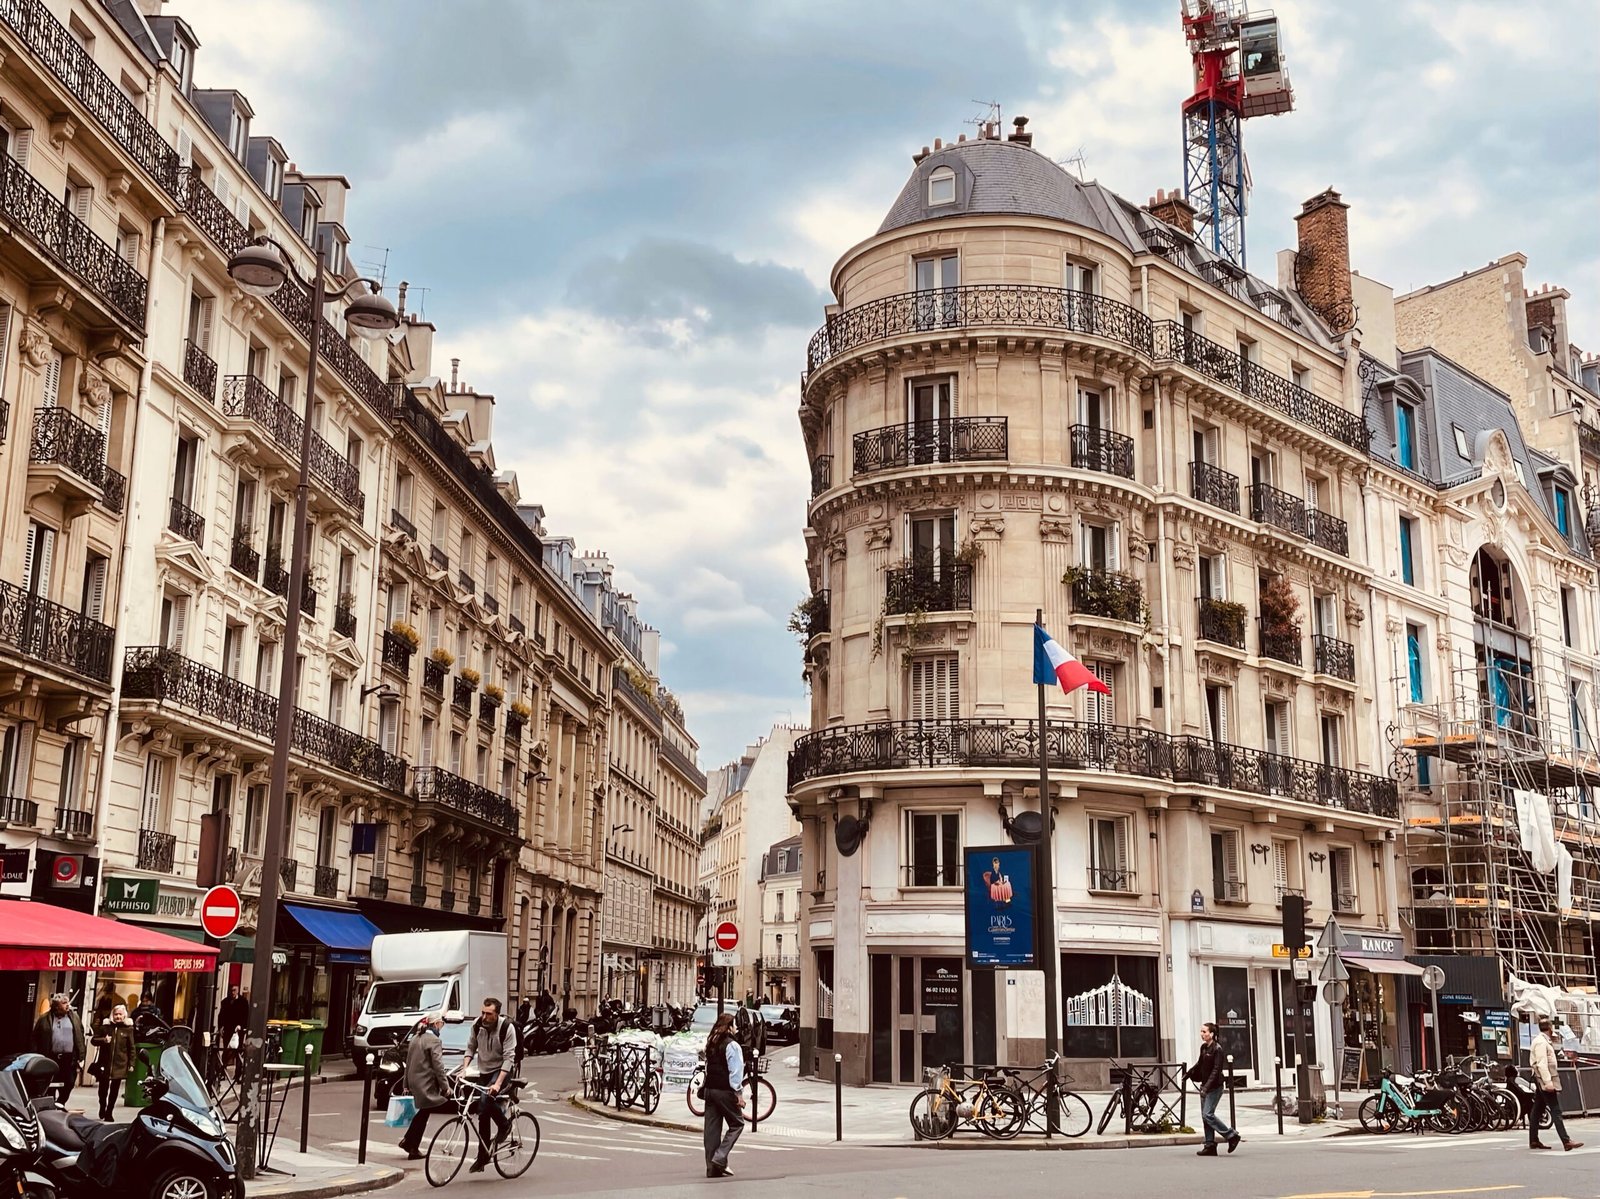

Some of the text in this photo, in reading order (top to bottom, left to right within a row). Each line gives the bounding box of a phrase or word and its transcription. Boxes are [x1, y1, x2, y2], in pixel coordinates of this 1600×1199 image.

[107, 900, 150, 911] MEPHISTO
[49, 952, 124, 968] AU SAUVIGNON
[173, 958, 205, 969] DEPUIS 1954
